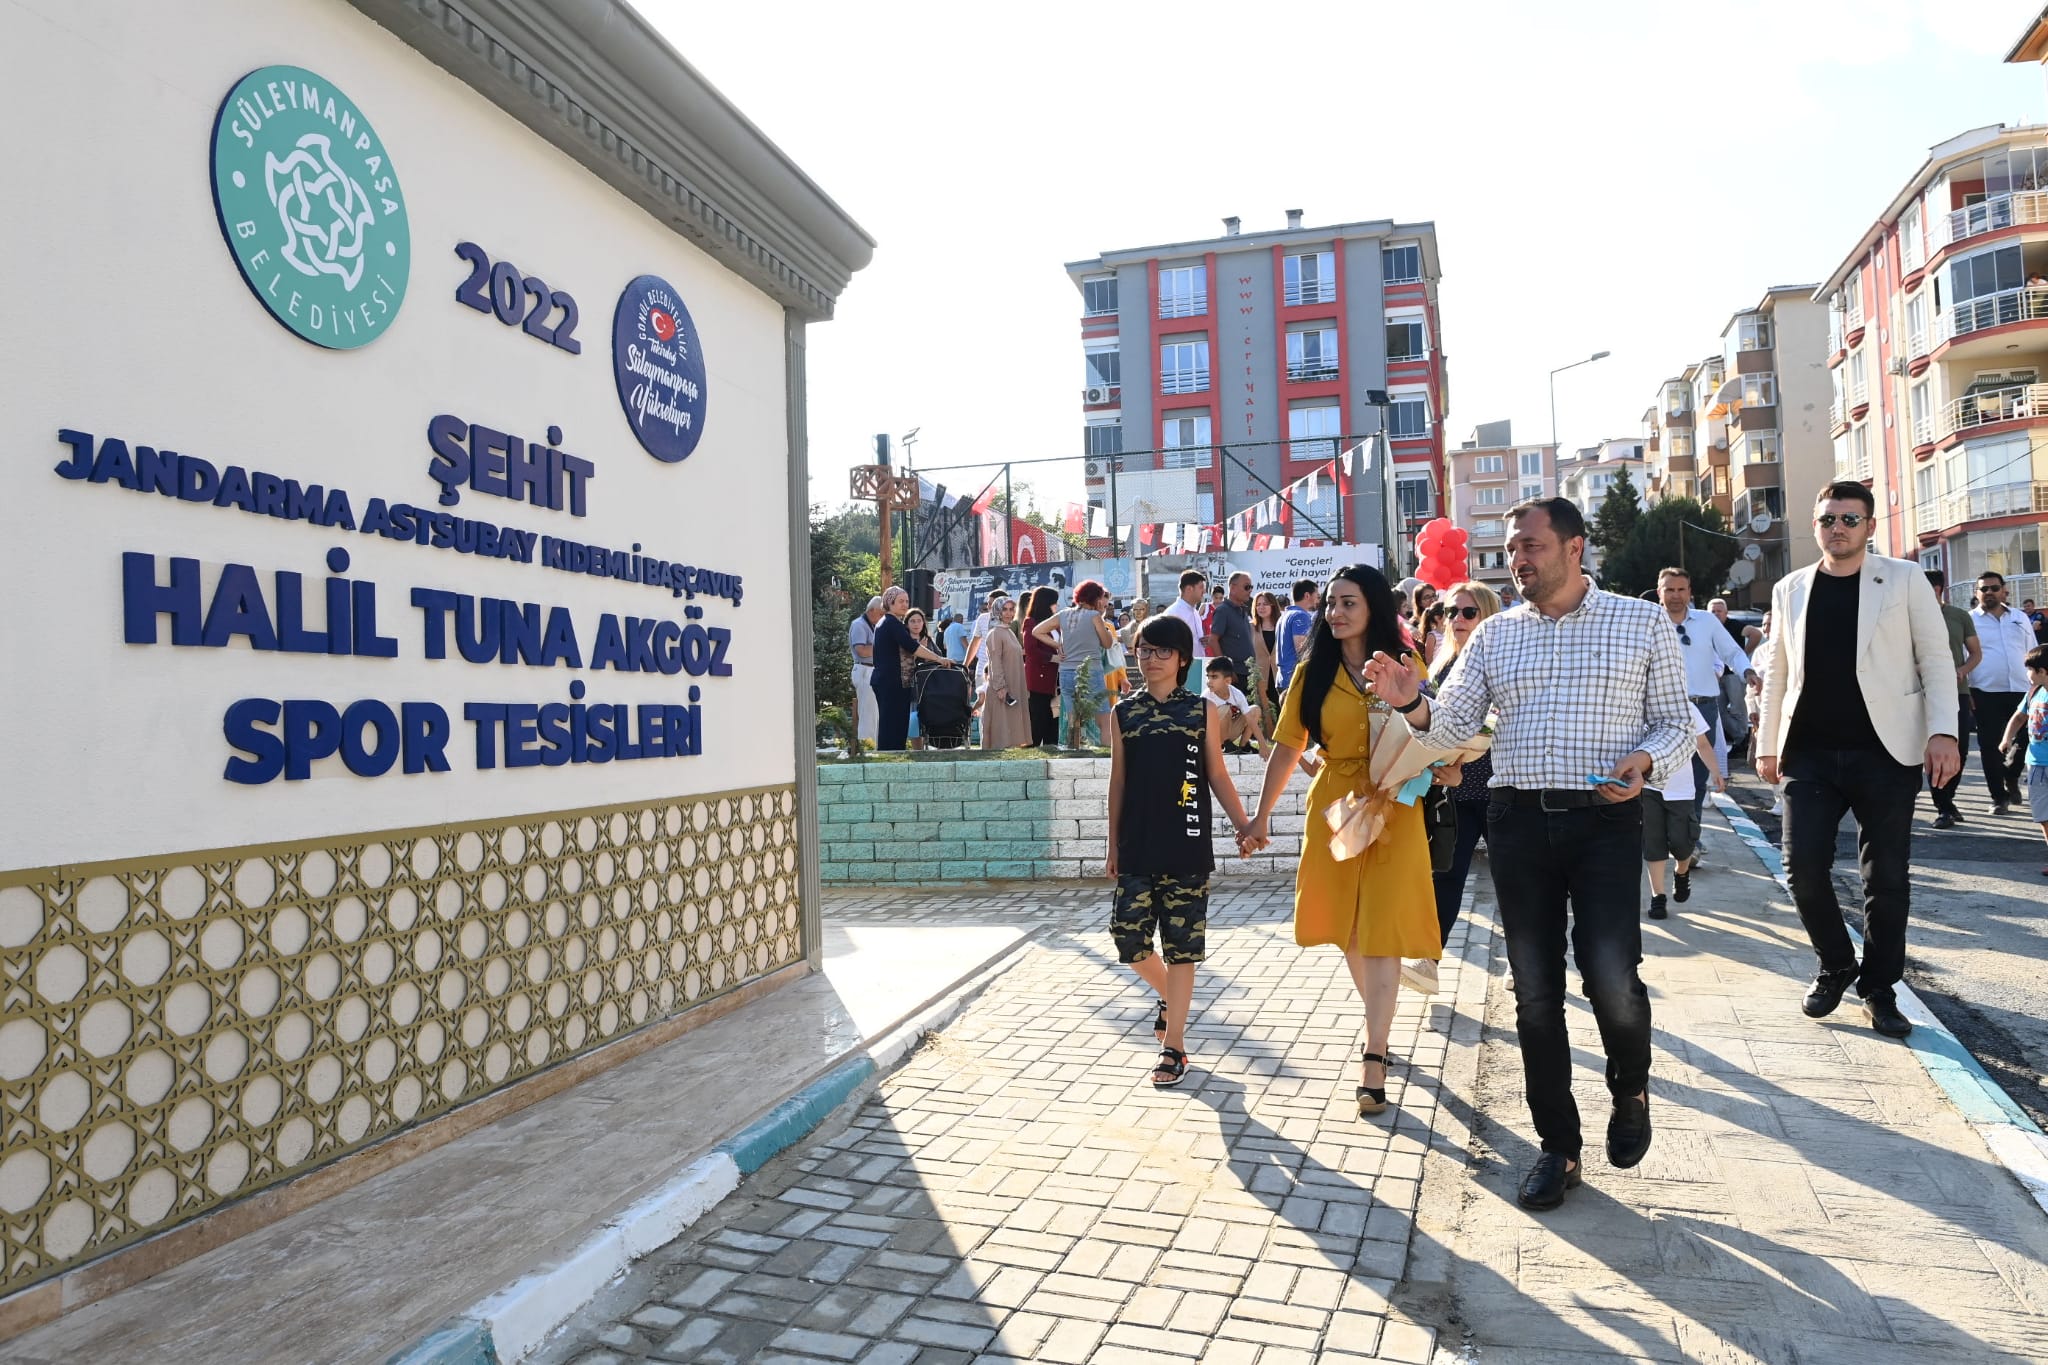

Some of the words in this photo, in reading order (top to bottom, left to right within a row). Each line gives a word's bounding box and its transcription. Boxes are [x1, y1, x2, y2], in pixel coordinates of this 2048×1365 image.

[232, 80, 399, 215] SÜLEYMANPAŞA
[236, 220, 395, 335] BELEDİYESİ
[454, 241, 582, 355] 2022
[625, 343, 699, 402] Süleymanpaşa
[630, 383, 691, 436] Yükseliyor
[54, 429, 357, 531] JANDARMA
[360, 497, 538, 564] ASTSUBAY
[541, 535, 642, 585] KIDEMLİ
[642, 557, 743, 607] BAŞÇAVUŞ
[428, 414, 595, 518] ŞEHİT
[122, 547, 399, 658] HALİL
[410, 587, 583, 669] TUNA
[590, 605, 733, 677] AKGÖZ
[1290, 569, 1299, 577] ki
[1302, 568, 1331, 578] hayal
[223, 698, 451, 784] SPOR
[464, 679, 703, 769] TESİSLERİ
